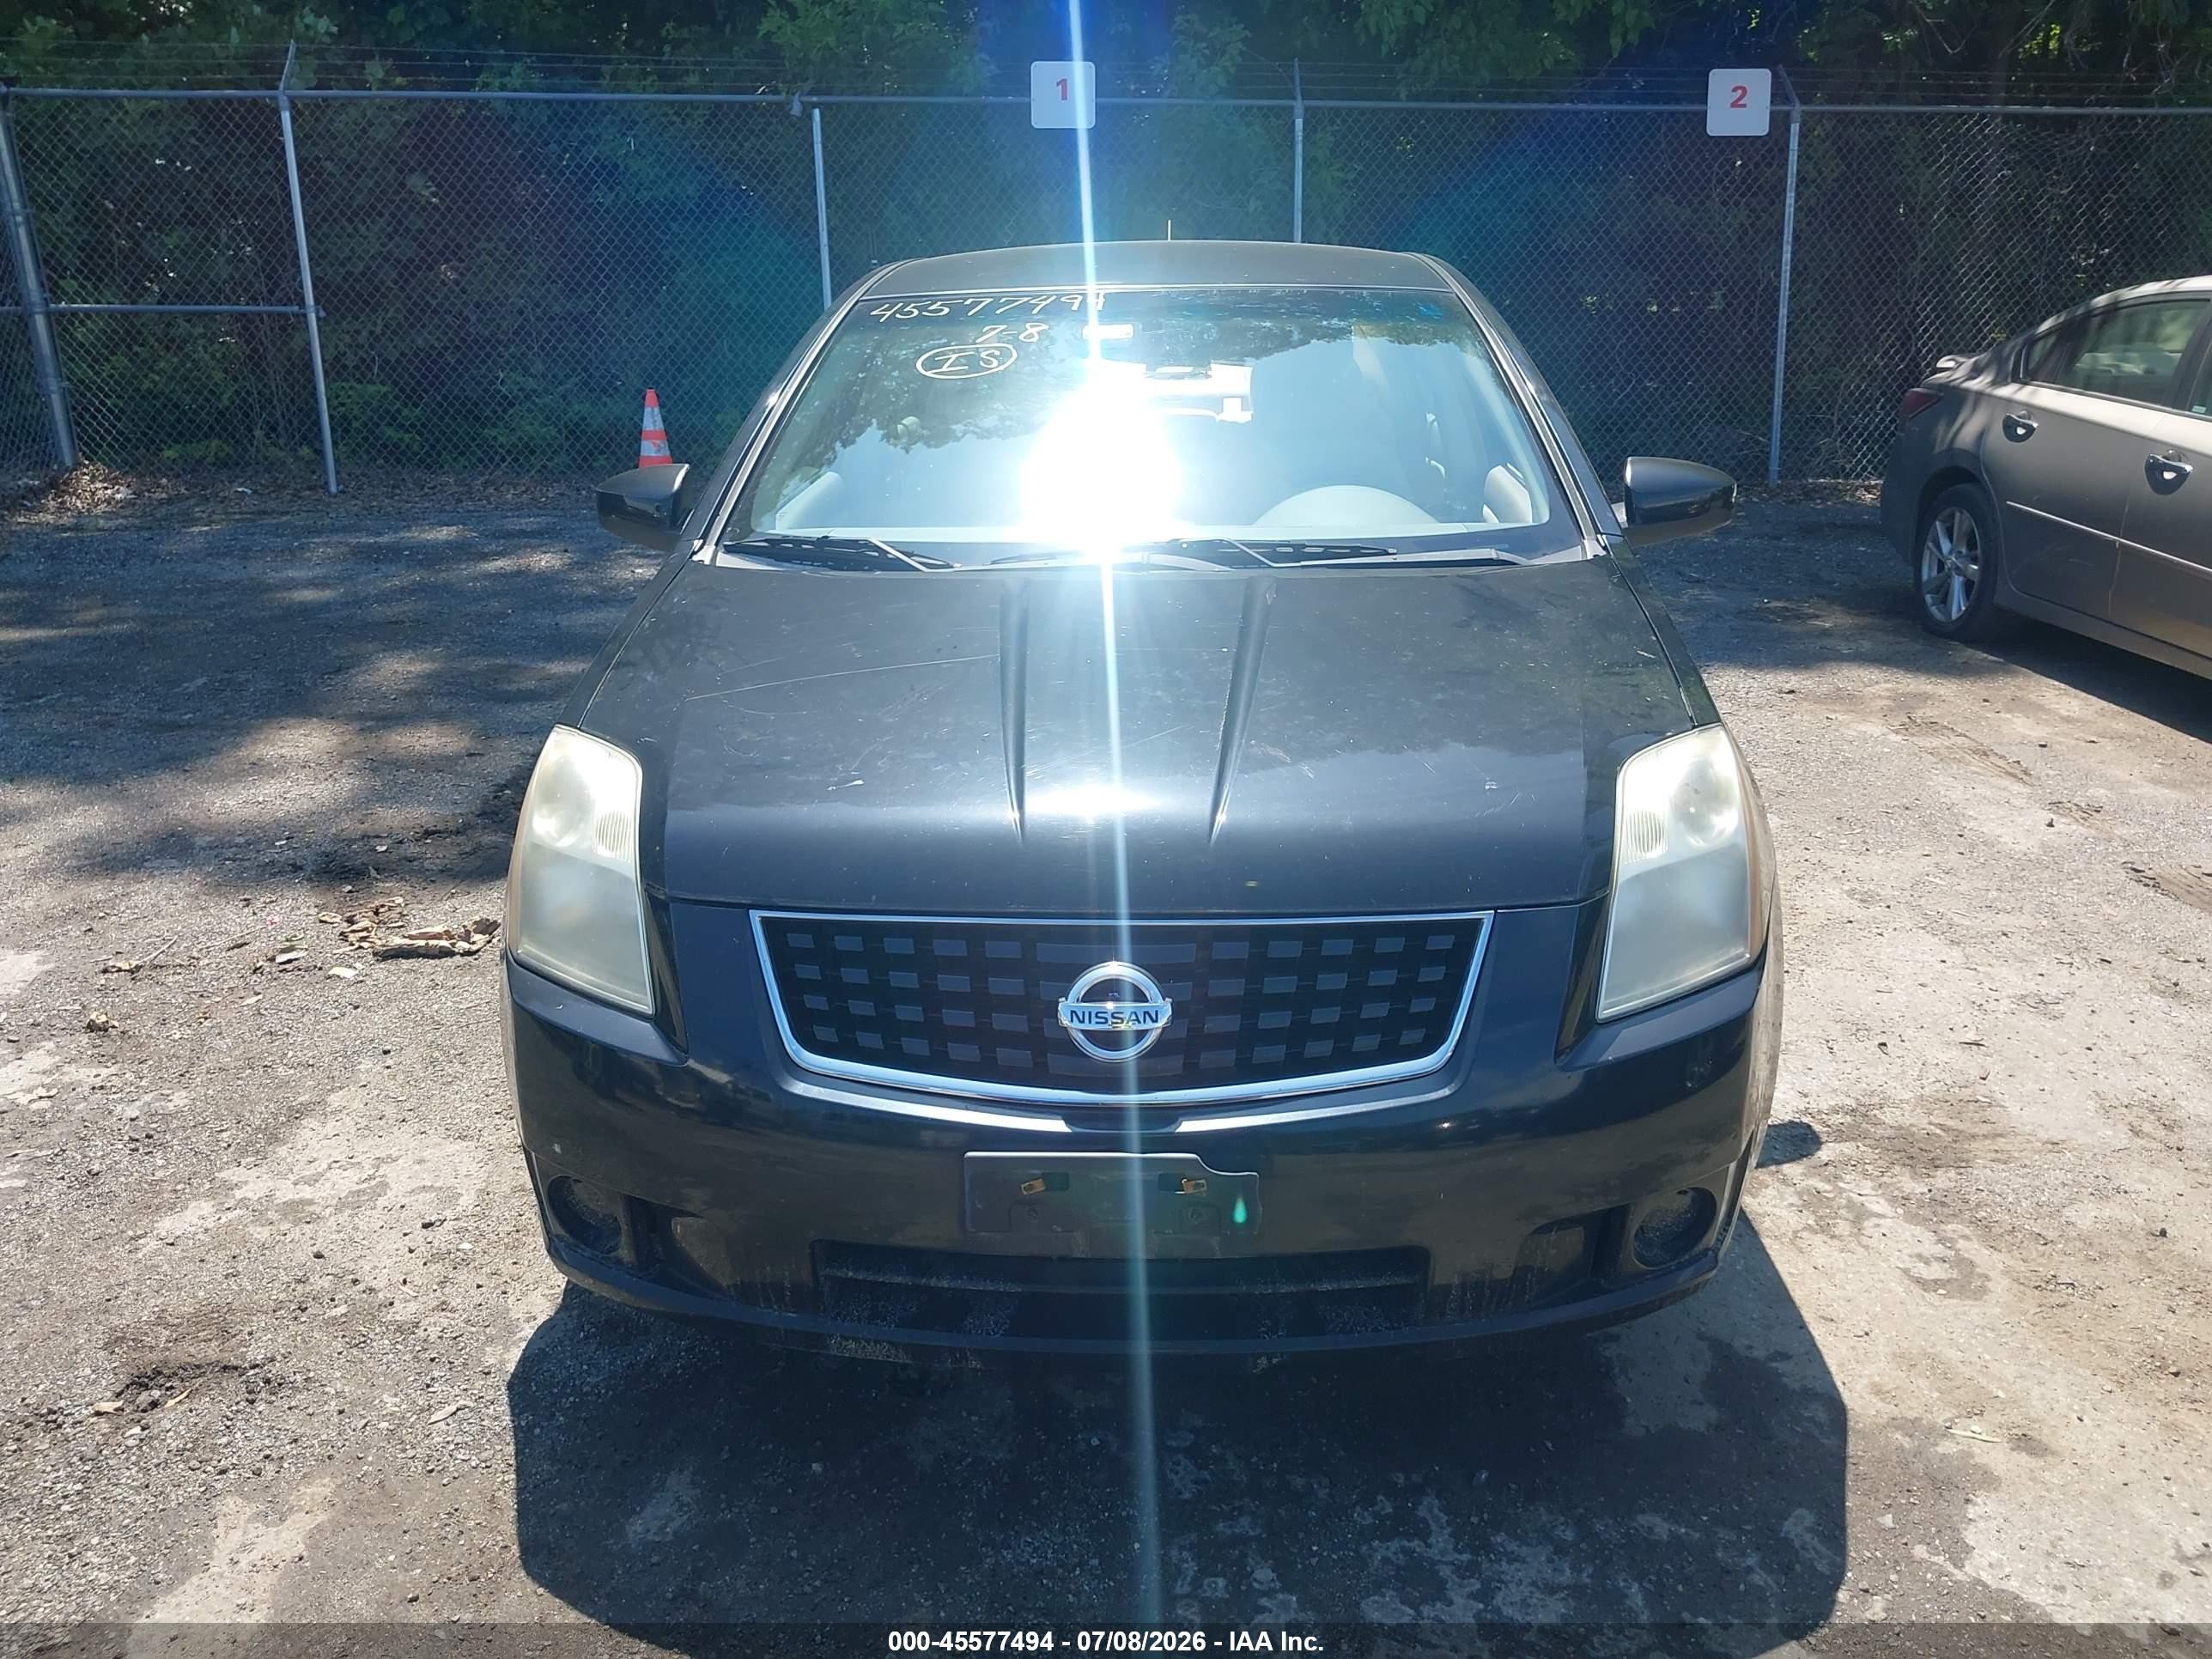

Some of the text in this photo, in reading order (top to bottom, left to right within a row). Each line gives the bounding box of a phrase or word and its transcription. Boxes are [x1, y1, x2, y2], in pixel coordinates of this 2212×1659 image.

[1055, 77, 1068, 101] 1
[1730, 84, 1748, 108] 2
[1070, 1010, 1159, 1026] NISSAN
